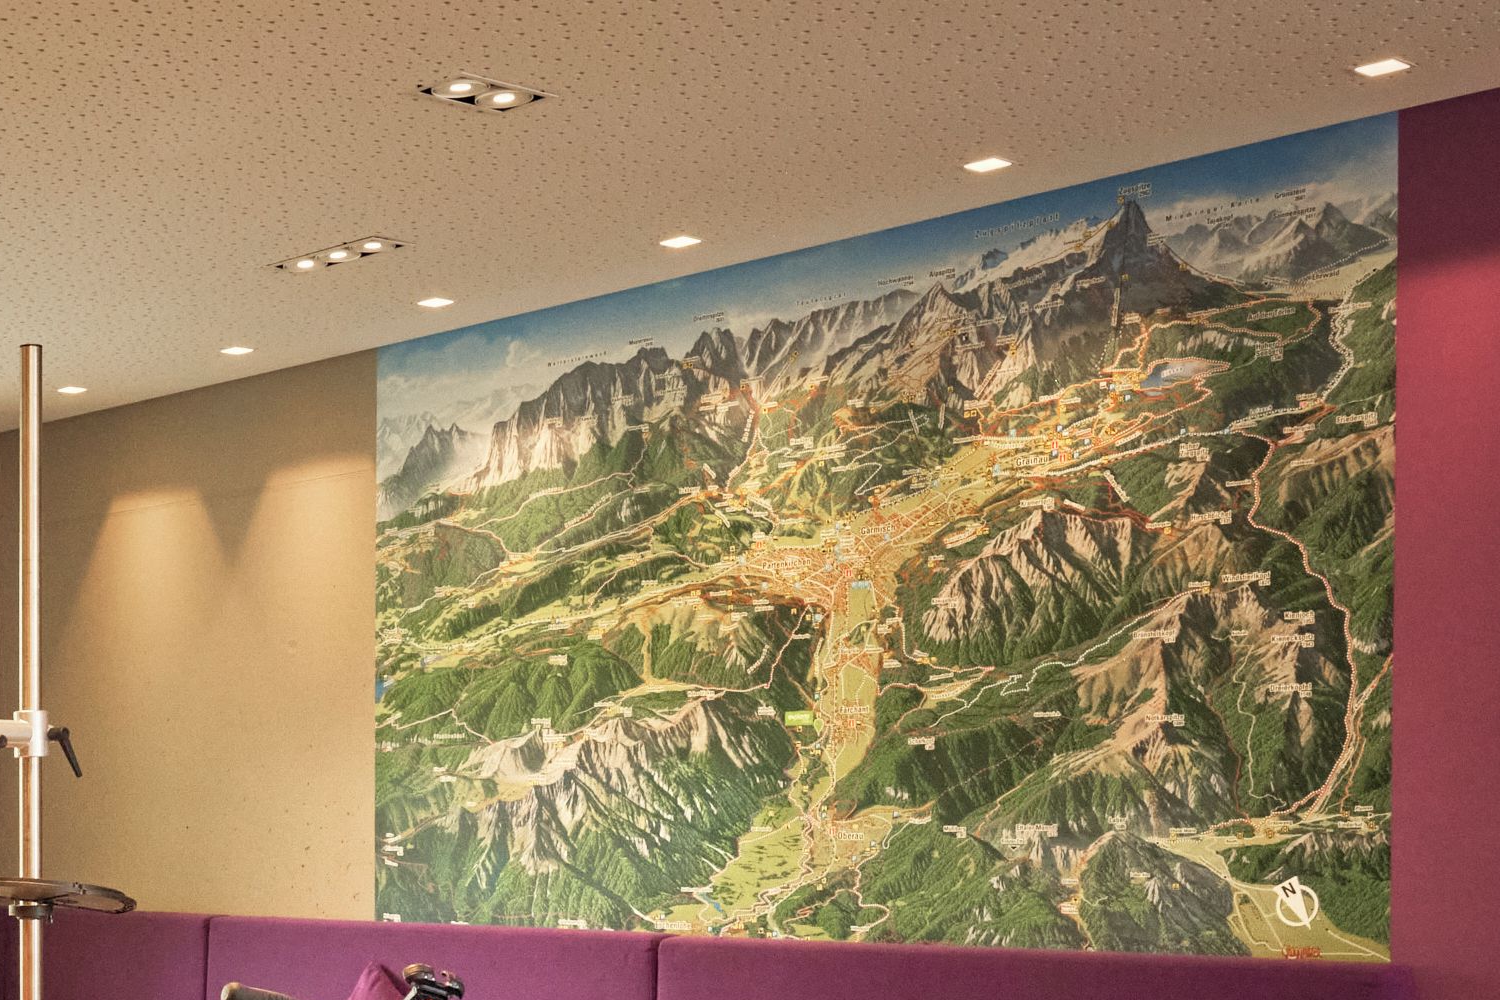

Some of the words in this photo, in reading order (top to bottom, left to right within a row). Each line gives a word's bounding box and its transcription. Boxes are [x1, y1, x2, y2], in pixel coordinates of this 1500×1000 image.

[1015, 456, 1048, 466] Grainau
[860, 525, 896, 535] Garmisch
[762, 558, 812, 570] Partenkirchen
[1281, 882, 1297, 899] N
